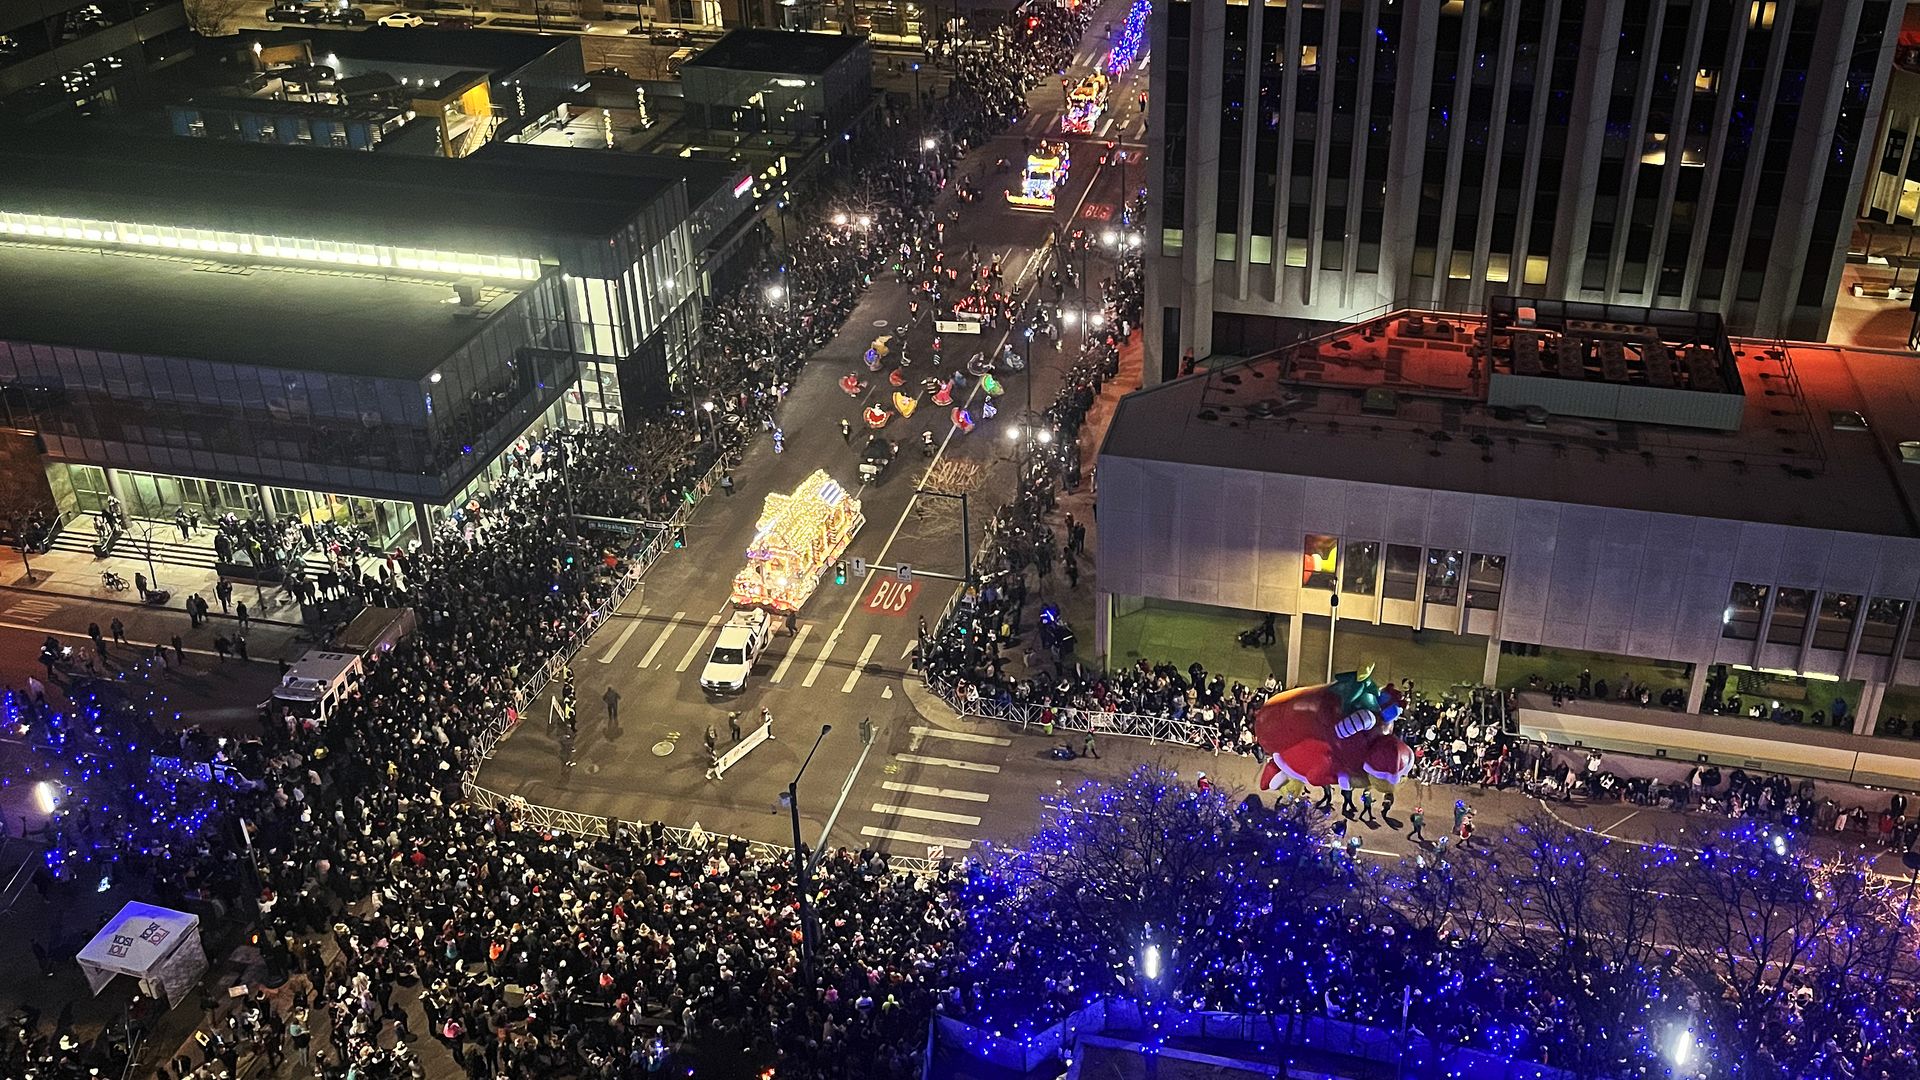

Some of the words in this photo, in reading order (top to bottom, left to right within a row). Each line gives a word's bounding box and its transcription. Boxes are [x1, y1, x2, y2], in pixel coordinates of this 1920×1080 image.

[1085, 205, 1111, 218] BUS
[870, 581, 912, 611] BUS
[140, 922, 160, 940] KOSI
[113, 935, 133, 946] KOSI
